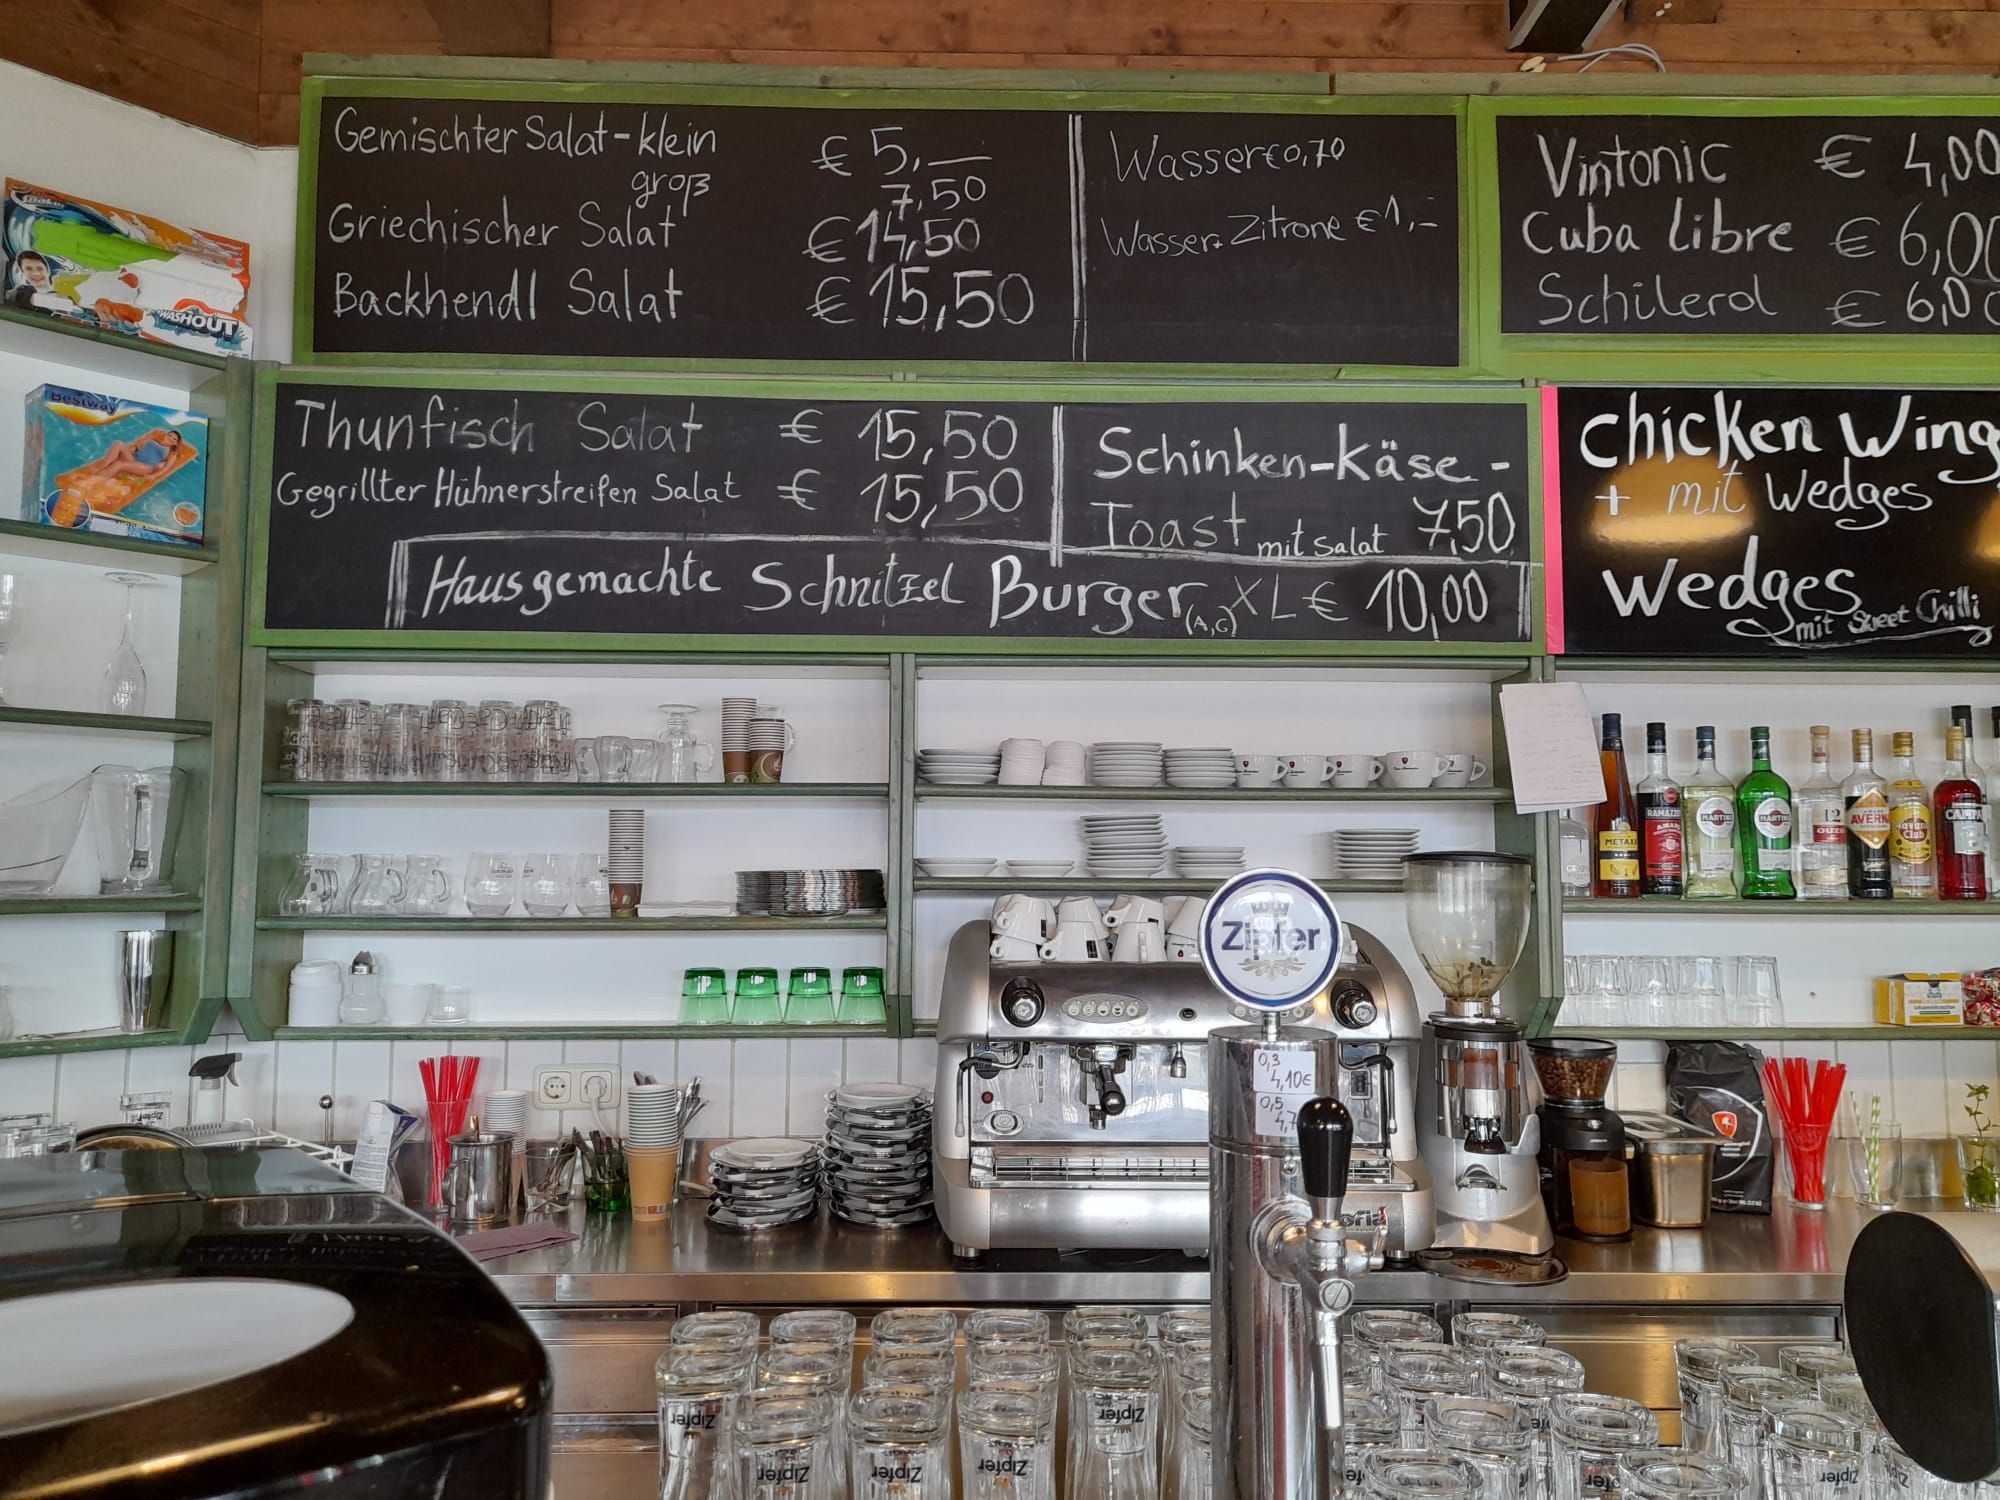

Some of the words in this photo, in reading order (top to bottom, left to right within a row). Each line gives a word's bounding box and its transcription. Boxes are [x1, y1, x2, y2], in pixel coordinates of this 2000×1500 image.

[334, 106, 518, 155] Gemischter
[812, 135, 852, 177] €
[1536, 133, 1732, 198] Vintonic
[1814, 134, 1872, 179] €
[1904, 127, 2000, 198] 4,00
[880, 175, 987, 221] 7,50
[328, 195, 560, 250] Griechischer
[578, 200, 677, 249] Salat
[802, 215, 851, 263] €
[855, 208, 980, 263] 14,50
[1227, 204, 1348, 245] Zitrone
[1354, 209, 1382, 233] €
[1521, 201, 1641, 254] Cuba
[1829, 216, 1882, 258] €
[333, 267, 537, 322] Backhendl
[567, 267, 684, 323] Salat
[806, 275, 855, 325] €
[868, 263, 1034, 332] 15,50
[1538, 272, 1779, 326] Schilerol
[1825, 289, 1887, 328] €
[159, 309, 239, 337] WASHOUT
[51, 392, 117, 416] Bestway
[295, 394, 535, 456] Thunfisch
[577, 401, 704, 455] Salat
[778, 408, 825, 444] €
[857, 407, 1019, 466] 15,50
[1838, 394, 2000, 485] Wing
[276, 466, 428, 519] Gegrillter
[433, 465, 638, 508] Hühnerstreifen
[650, 470, 742, 505] Salat
[776, 468, 821, 511] €
[859, 466, 1025, 530] 15,50
[1667, 459, 1746, 516] mit
[1765, 456, 1933, 531] Wedges
[1090, 490, 1247, 552] Toast
[1257, 518, 1305, 562] mit
[1412, 490, 1517, 557] 7,50
[742, 552, 967, 615] Schnitzel
[989, 554, 1209, 637] Burger
[1301, 581, 1350, 622] €
[1365, 566, 1489, 642] 10,00
[1602, 535, 1863, 638] Wedges
[1795, 614, 1835, 642] mit
[1916, 585, 1982, 624] Chilli
[1850, 813, 1889, 825] AVERN
[1221, 920, 1321, 962] Zipfer
[1258, 1052, 1281, 1073] 0,3
[1260, 1096, 1284, 1113] 0,5
[1274, 1110, 1298, 1134] 4,7
[670, 1413, 717, 1430] Zipfer
[1099, 1407, 1146, 1424] Zipfer
[757, 1465, 810, 1484] Zipfer
[871, 1465, 922, 1483] Zipfer
[978, 1458, 1028, 1477] Zipfer
[1819, 1466, 1860, 1486] Zipfer
